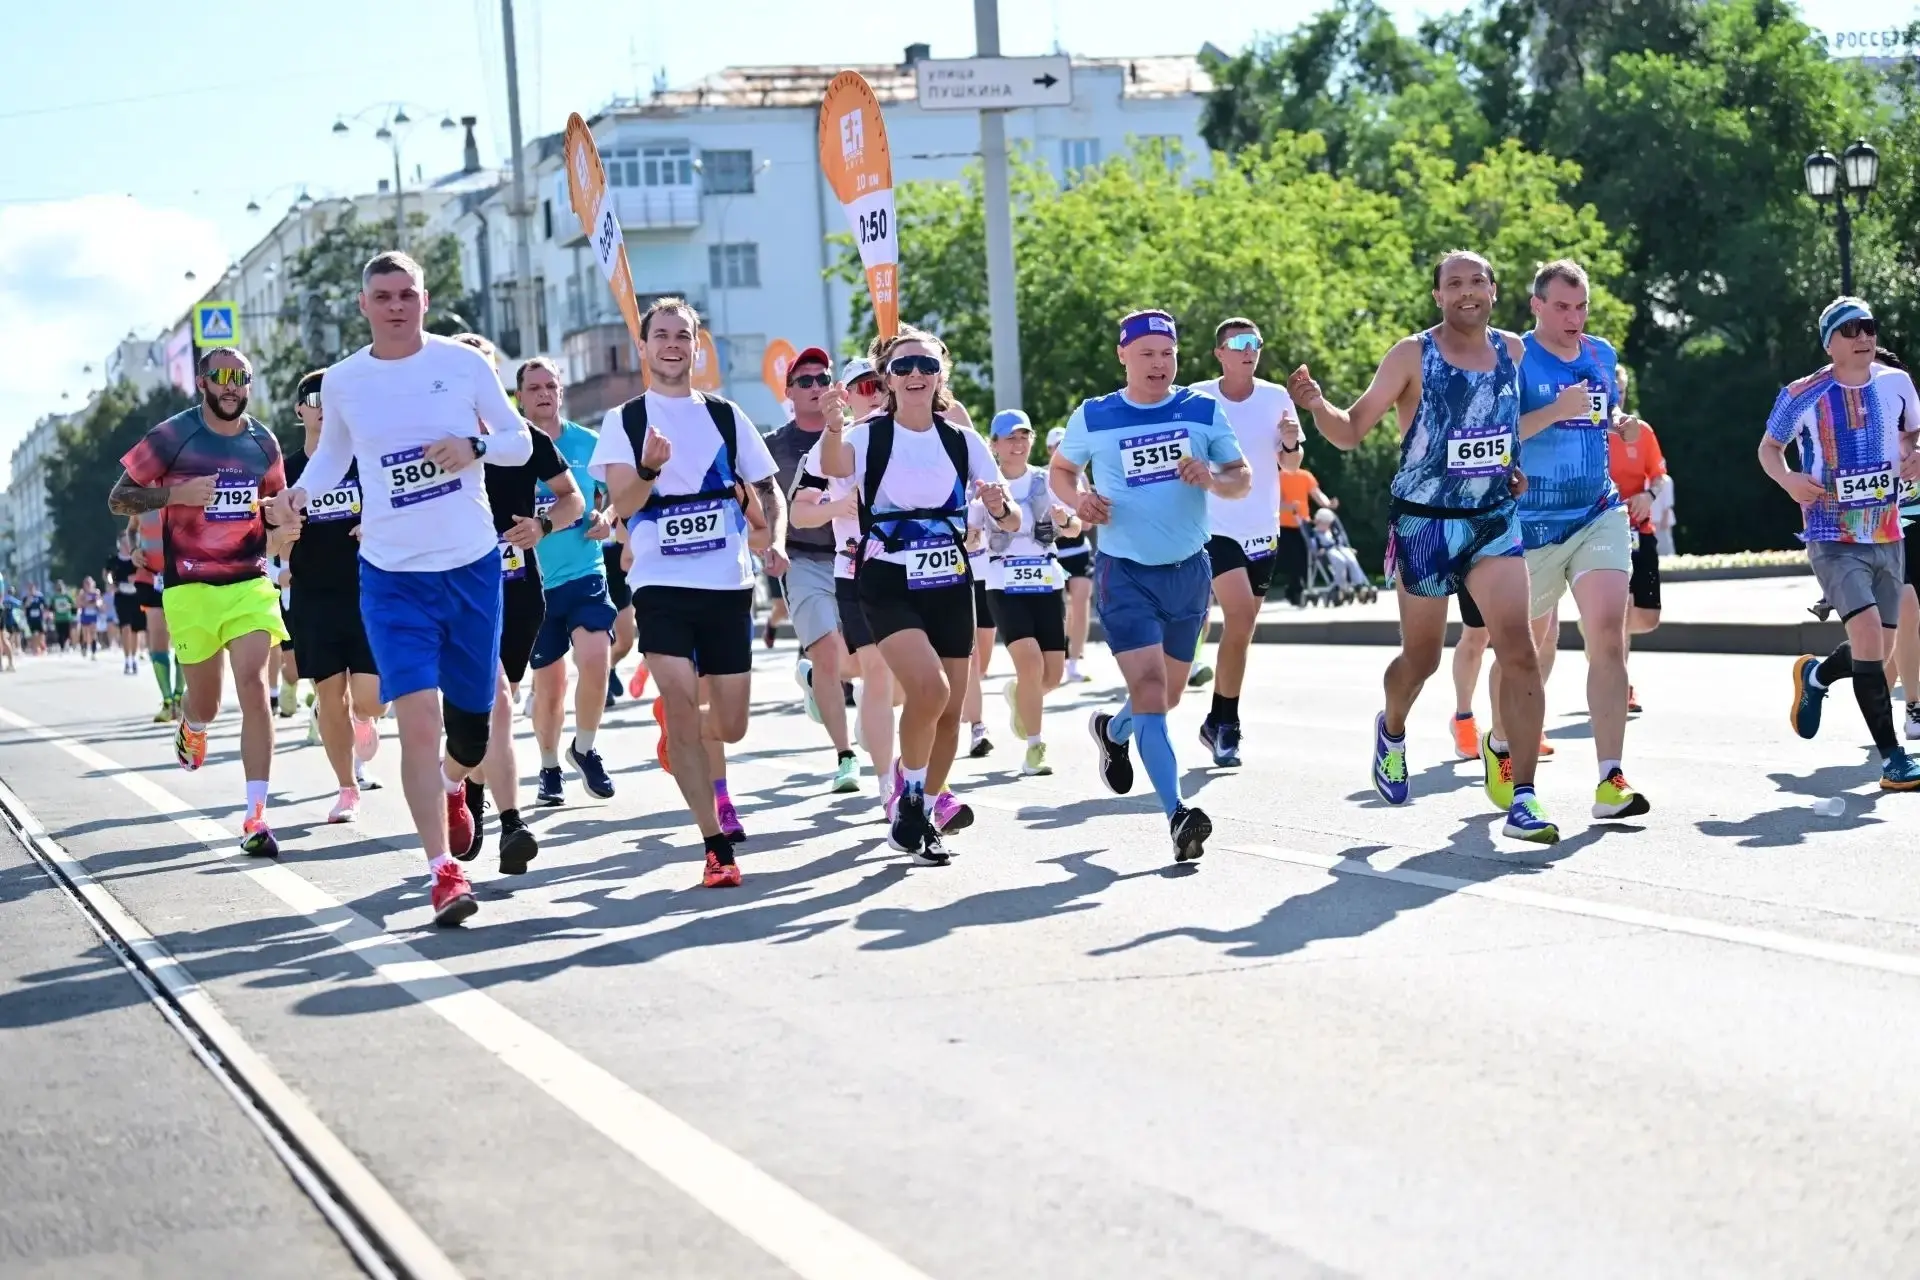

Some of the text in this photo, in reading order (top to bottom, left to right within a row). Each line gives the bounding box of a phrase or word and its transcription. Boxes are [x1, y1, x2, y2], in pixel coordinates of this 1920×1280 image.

[928, 84, 1013, 98] ПУШКИНА
[856, 174, 866, 191] 10
[860, 208, 887, 244] 0:50
[600, 211, 614, 264] 0:50
[1132, 443, 1182, 467] 5315
[1458, 439, 1505, 459] 6615
[391, 460, 446, 487] 580
[1843, 474, 1890, 494] 5448
[213, 490, 252, 505] 7192
[312, 491, 354, 508] 6001
[666, 514, 717, 537] 6987
[915, 548, 958, 570] 7015
[1014, 567, 1043, 580] 354
